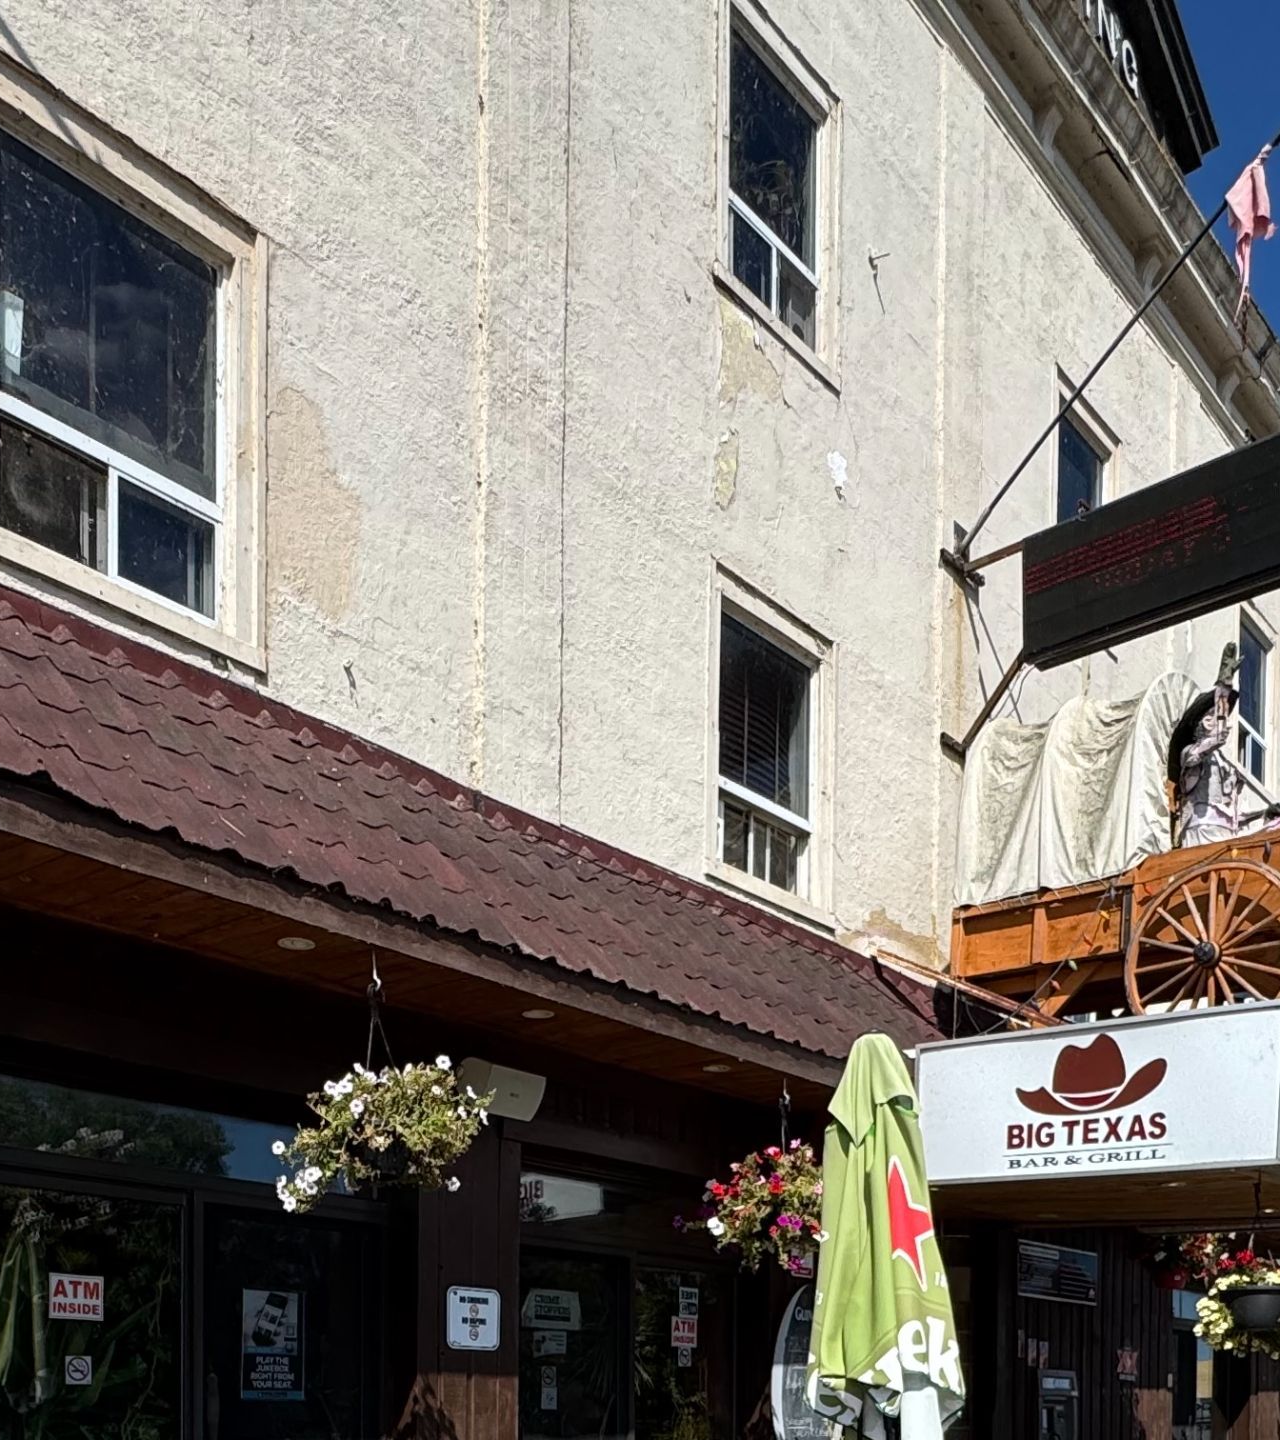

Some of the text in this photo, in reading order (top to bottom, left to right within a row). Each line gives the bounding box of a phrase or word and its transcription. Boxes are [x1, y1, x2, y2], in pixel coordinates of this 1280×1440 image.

[1007, 1112, 1167, 1150] BIG TEXAS
[1008, 1149, 1167, 1169] BAR & GRILL
[52, 1279, 101, 1300] ATM
[52, 1303, 101, 1316] INSIDE
[673, 1320, 695, 1333] ATM
[275, 1356, 289, 1365] THE
[273, 1372, 295, 1381] FROM
[251, 1380, 272, 1389] YOUR
